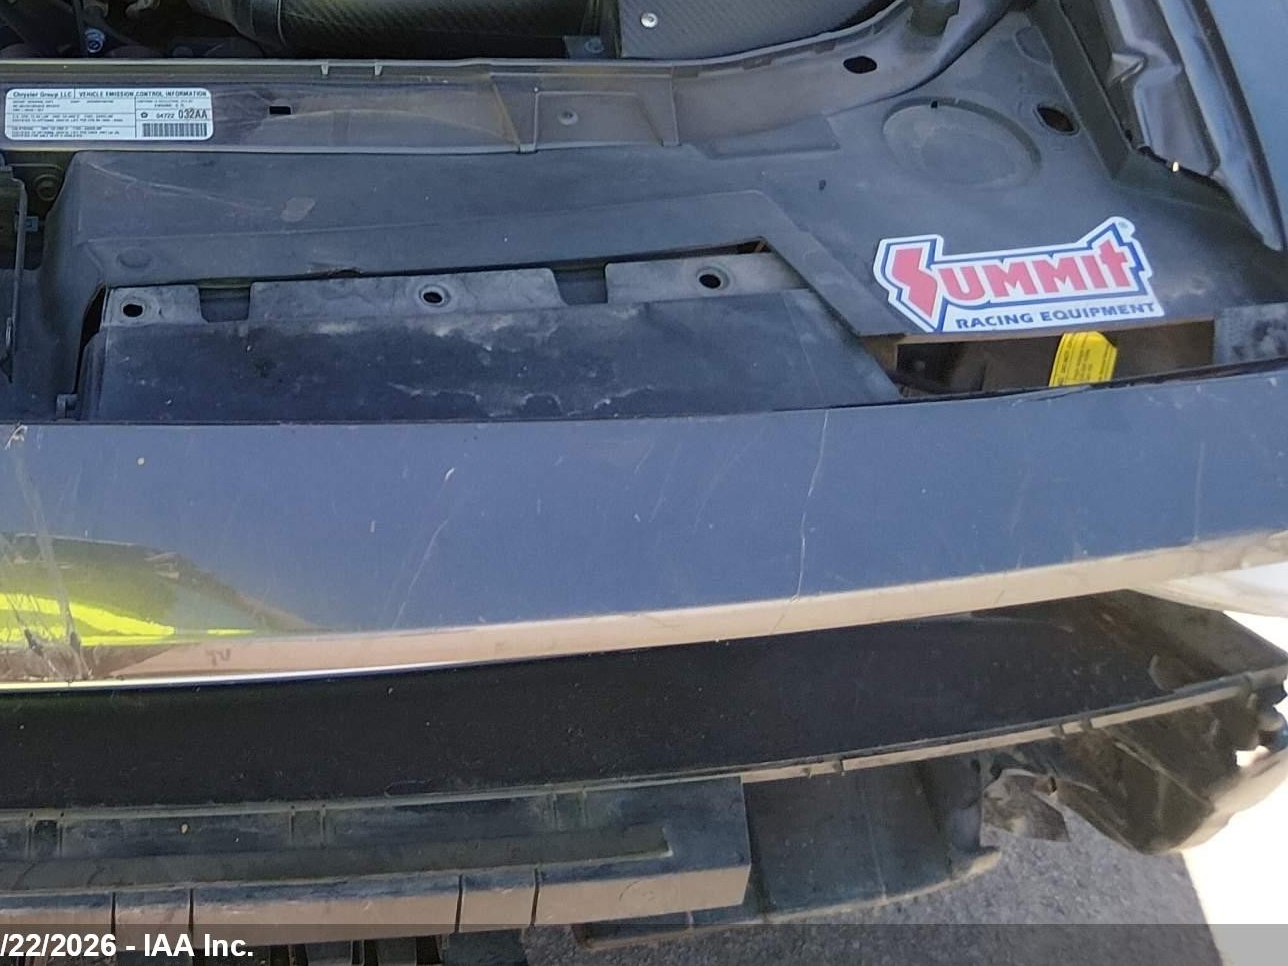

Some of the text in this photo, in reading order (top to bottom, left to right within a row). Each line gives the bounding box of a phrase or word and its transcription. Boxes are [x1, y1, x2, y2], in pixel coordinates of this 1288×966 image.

[12, 90, 38, 98] Chrysler
[40, 90, 59, 98] Group
[178, 108, 208, 119] 032AA
[955, 302, 1156, 329] RACING EQUIPMENT
